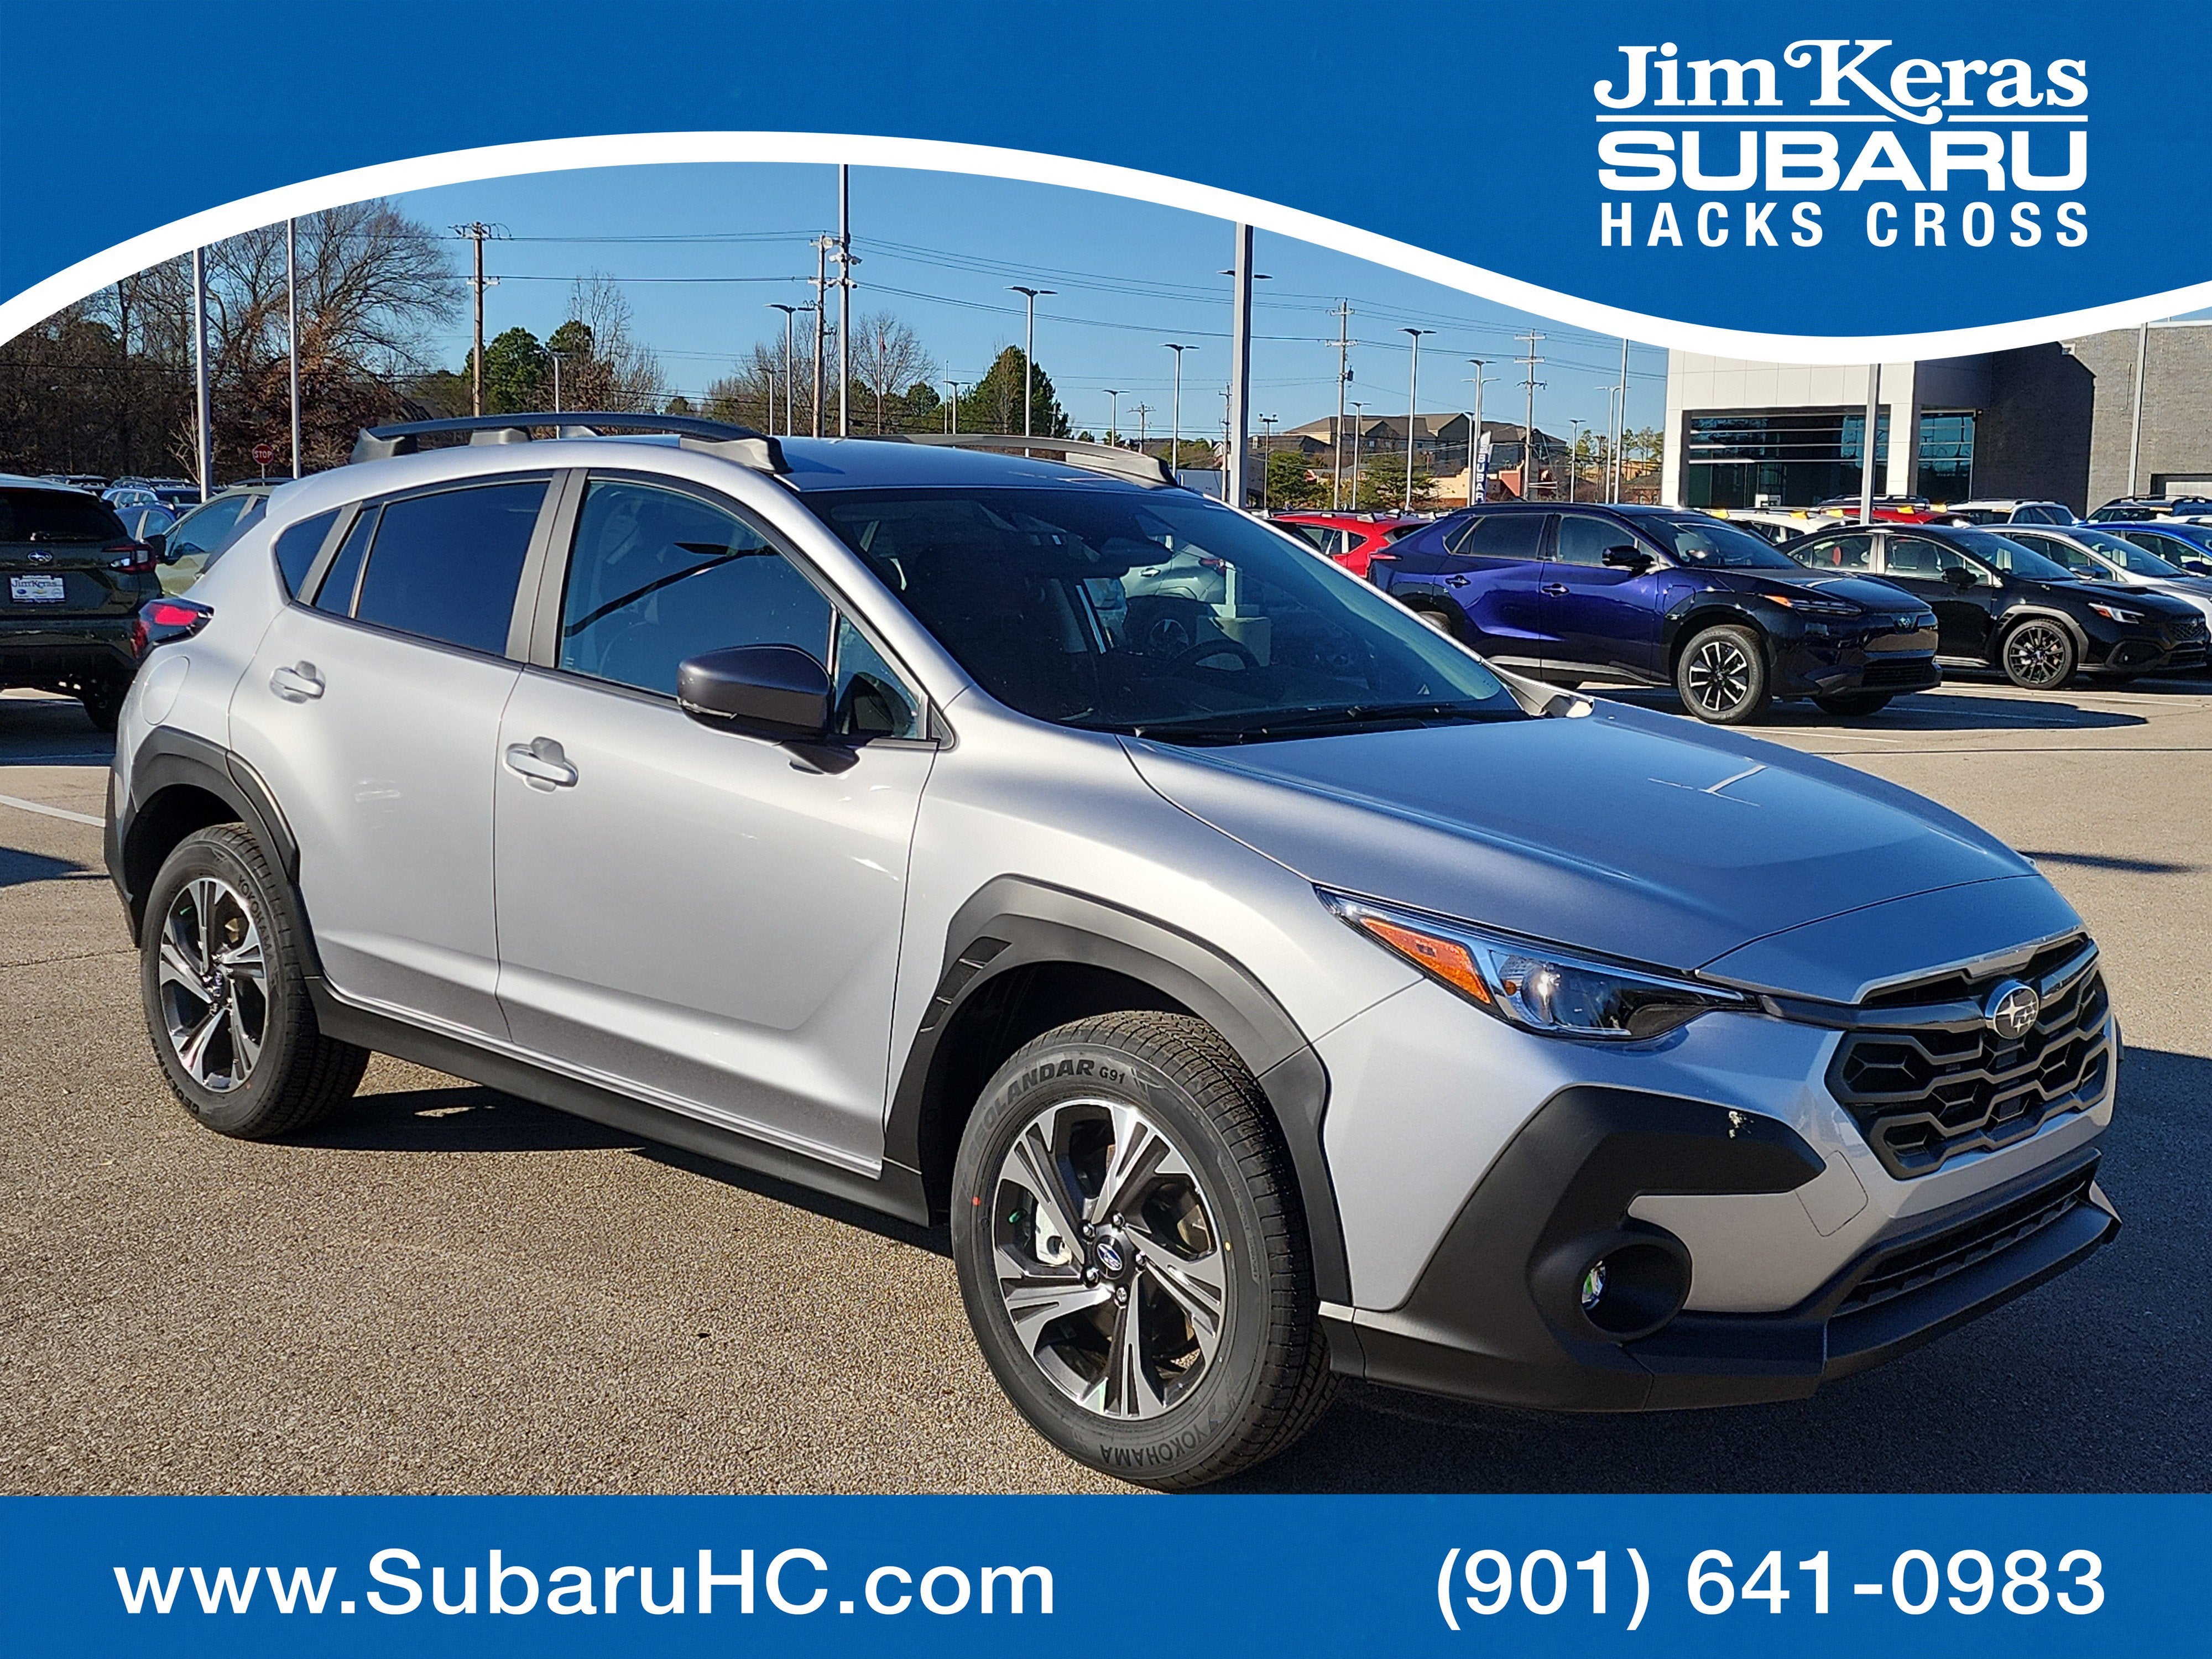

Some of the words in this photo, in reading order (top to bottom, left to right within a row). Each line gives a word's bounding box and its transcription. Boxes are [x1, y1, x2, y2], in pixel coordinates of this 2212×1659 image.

[254, 450, 272, 458] STOP
[1475, 453, 1486, 502] SUBAR
[968, 1059, 1095, 1167] GEOLANDAR
[1099, 1066, 1126, 1084] G91
[1099, 1423, 1208, 1467] YOKOHAMA
